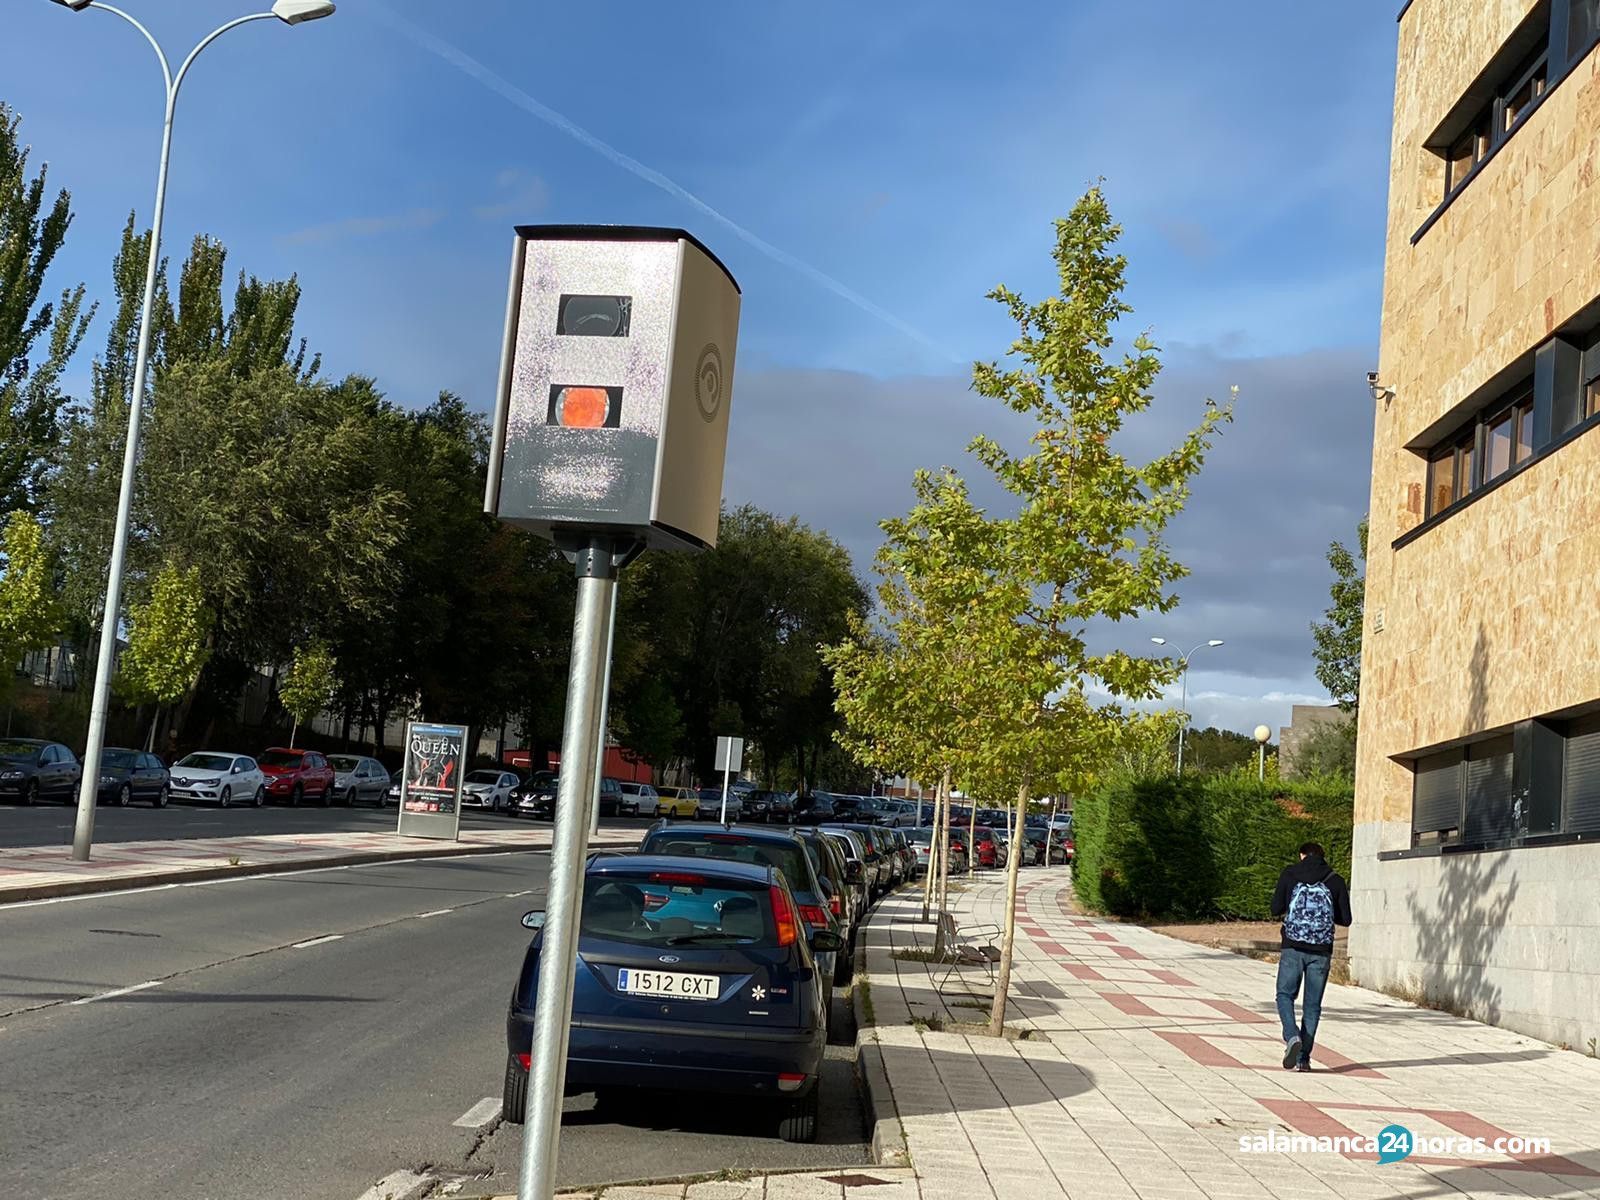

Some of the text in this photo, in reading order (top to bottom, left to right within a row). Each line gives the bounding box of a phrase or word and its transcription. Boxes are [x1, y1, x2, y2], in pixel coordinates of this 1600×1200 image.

[411, 738, 460, 758] QUEEN
[634, 973, 714, 995] 1512 CXT
